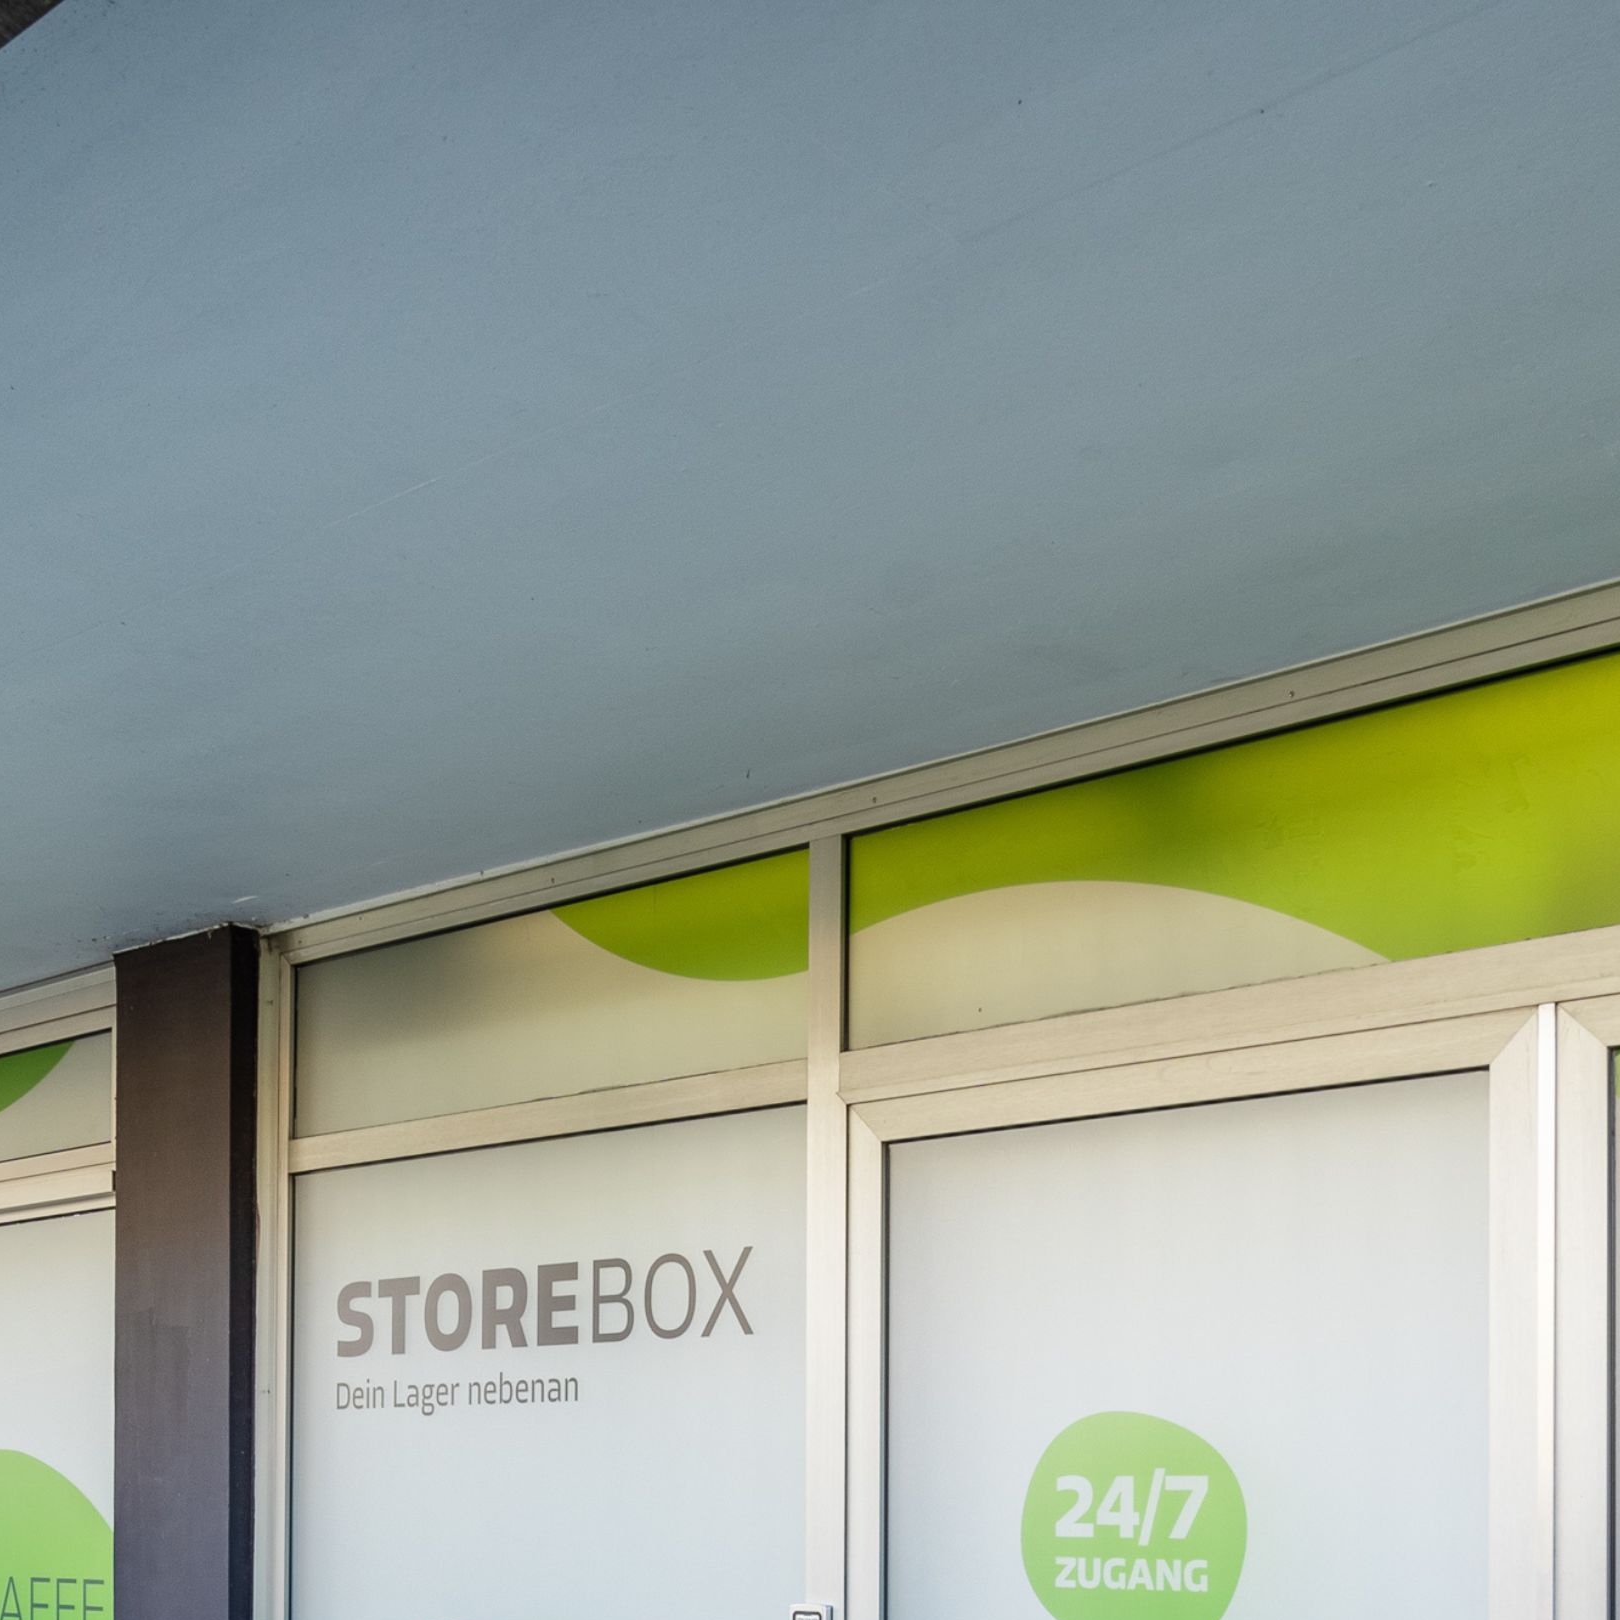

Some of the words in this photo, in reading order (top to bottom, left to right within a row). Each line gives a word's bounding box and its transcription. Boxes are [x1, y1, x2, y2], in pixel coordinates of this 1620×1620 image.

[335, 1244, 755, 1358] STOREBOX
[335, 1379, 385, 1411] Dein
[392, 1378, 461, 1416] Lager
[467, 1370, 580, 1406] nebenan
[1053, 1467, 1210, 1547] 24/7
[1053, 1556, 1209, 1593] ZUGANG
